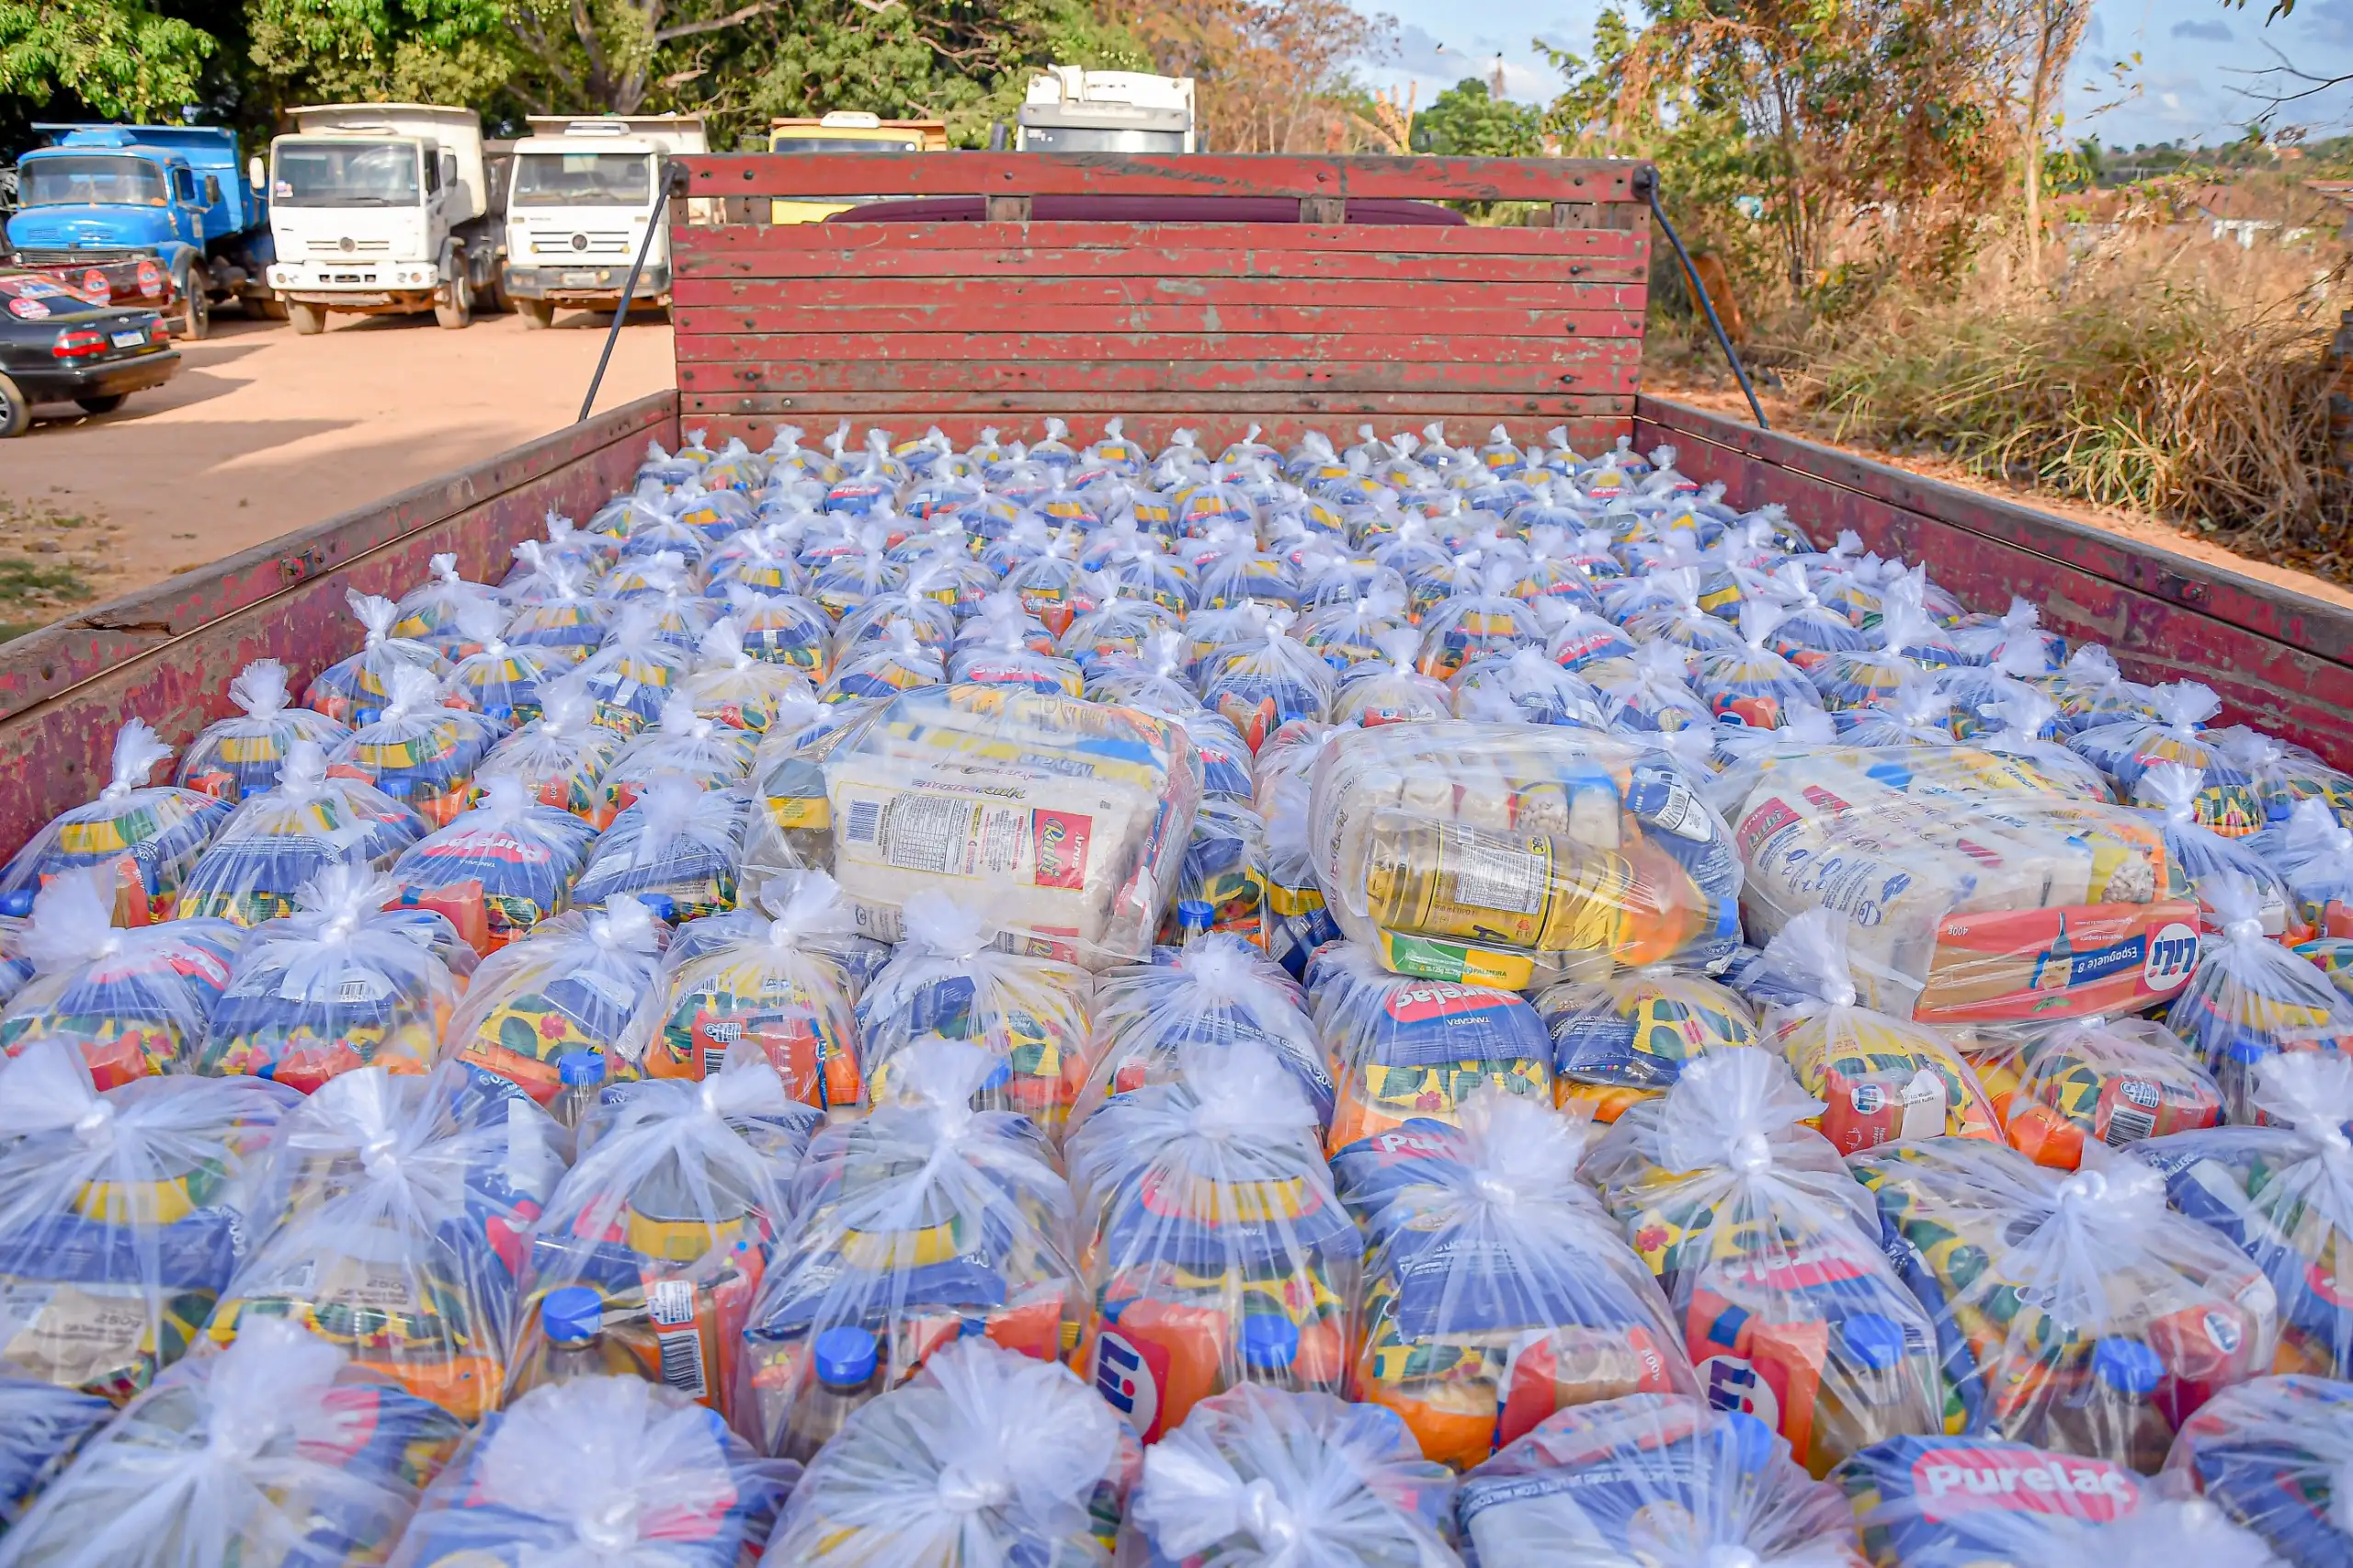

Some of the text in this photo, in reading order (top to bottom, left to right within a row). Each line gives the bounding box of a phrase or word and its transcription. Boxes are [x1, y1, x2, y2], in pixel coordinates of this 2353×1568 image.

[1039, 817, 1066, 878] Rubi
[1071, 831, 1086, 869] Arroz
[1948, 924, 1969, 937] 400g
[1473, 968, 1507, 978] PALMEIRA
[2077, 946, 2138, 973] Espaguete 8
